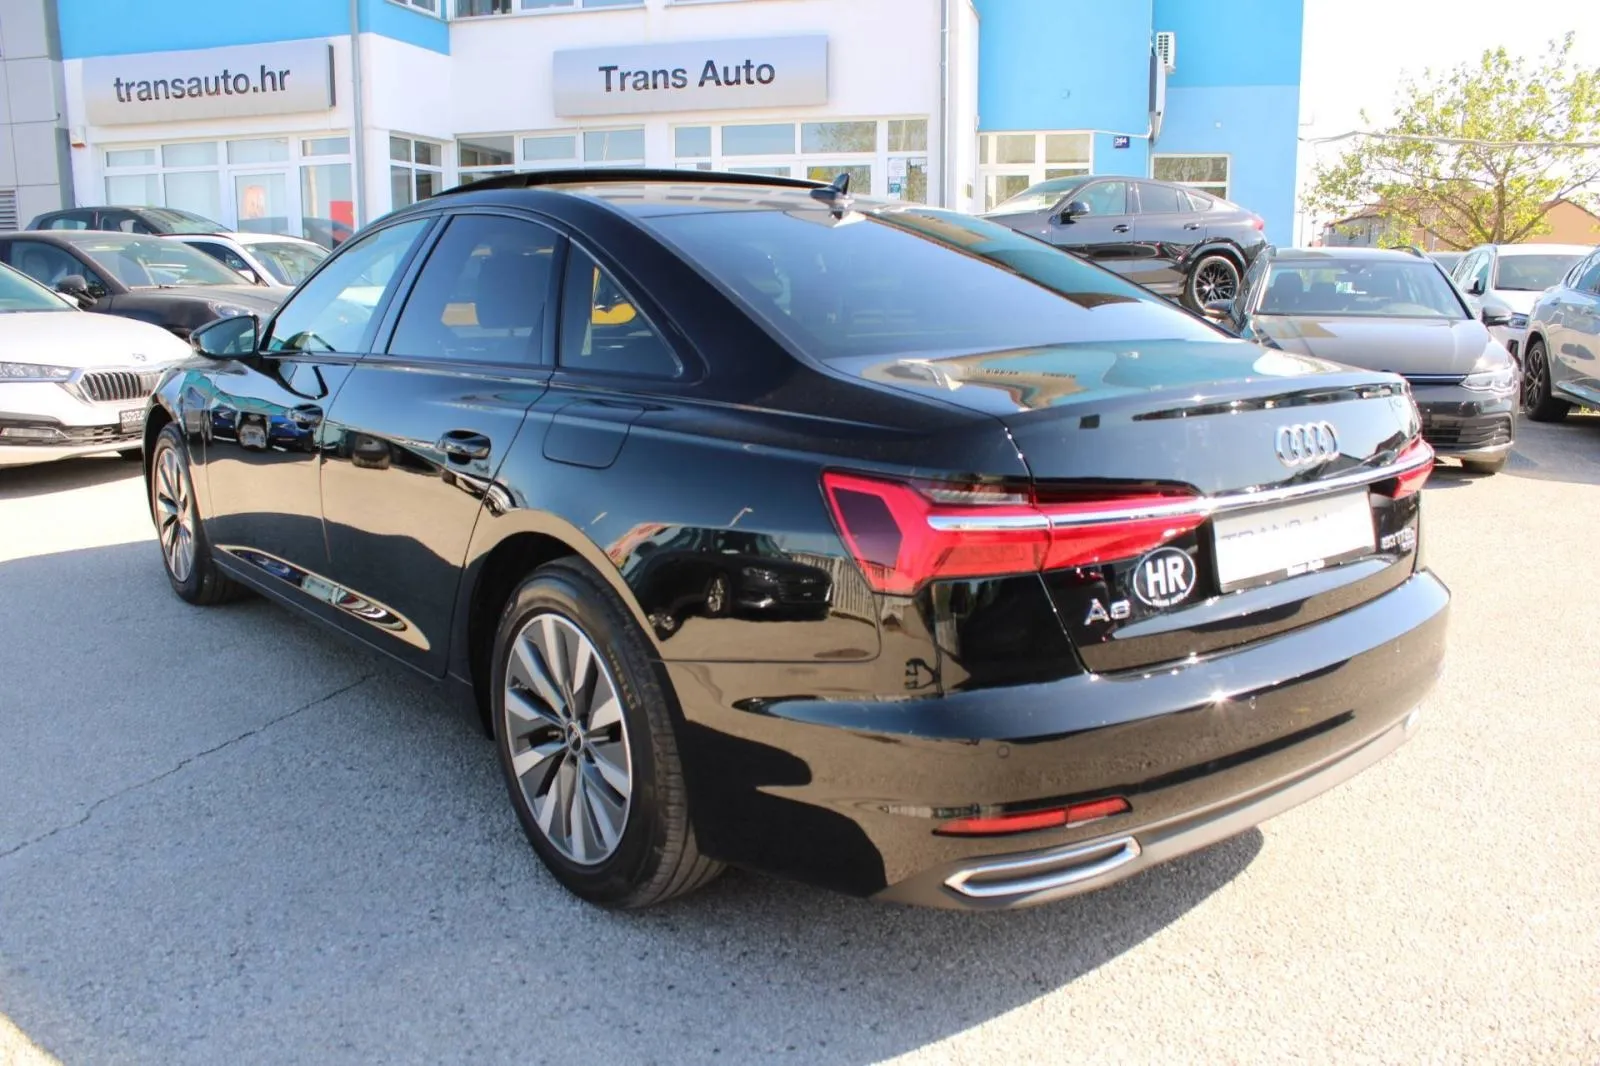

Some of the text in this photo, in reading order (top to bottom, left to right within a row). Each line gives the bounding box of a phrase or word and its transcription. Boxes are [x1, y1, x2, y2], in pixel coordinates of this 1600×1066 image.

[113, 64, 291, 103] transauto.hr
[598, 59, 776, 93] Trans Auto
[1145, 556, 1187, 598] HR
[1084, 598, 1130, 626] A6
